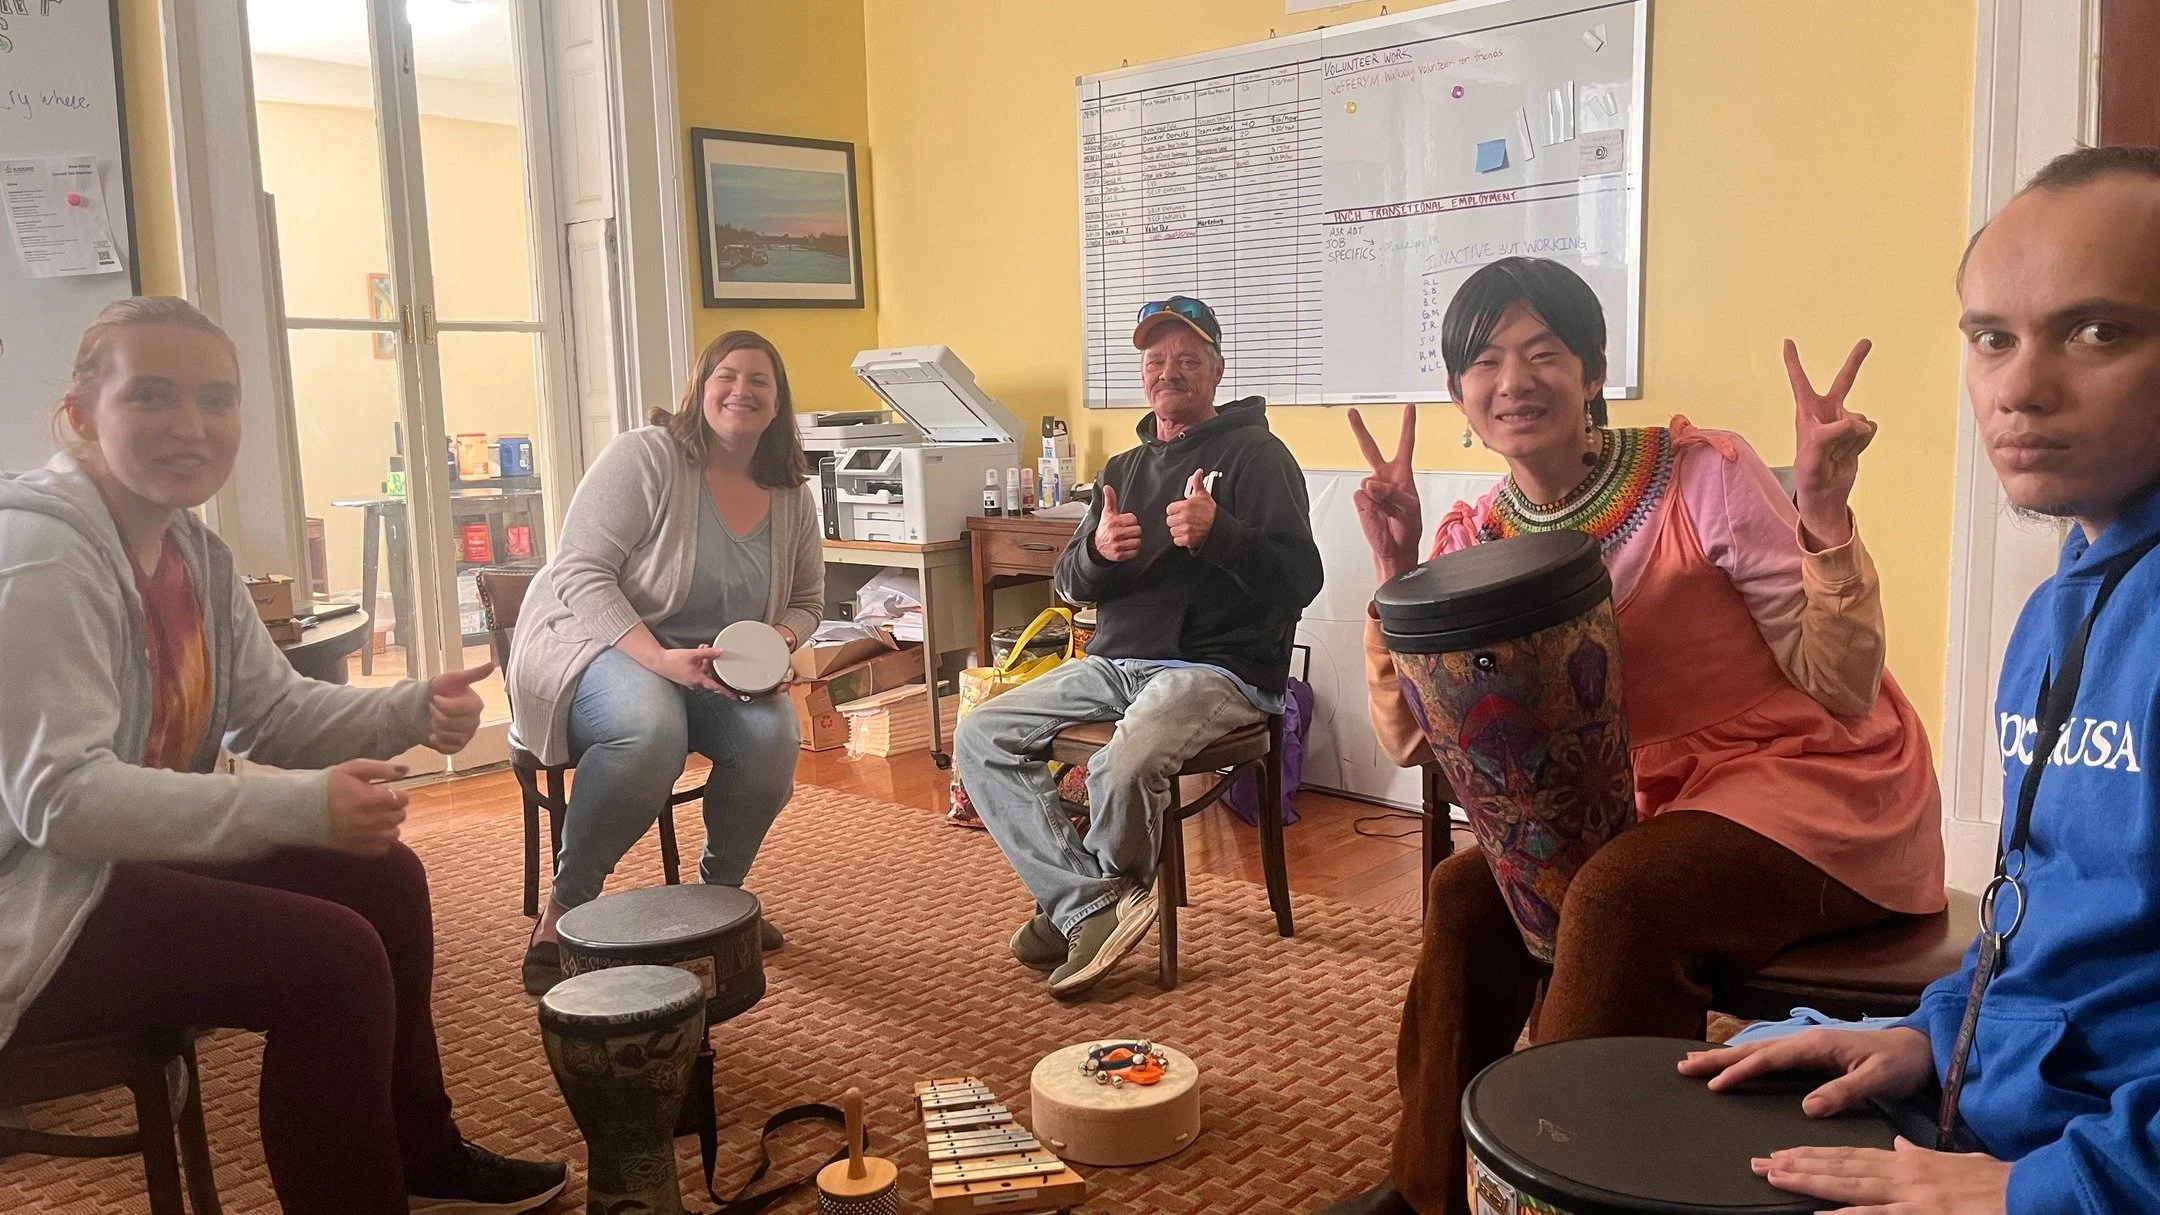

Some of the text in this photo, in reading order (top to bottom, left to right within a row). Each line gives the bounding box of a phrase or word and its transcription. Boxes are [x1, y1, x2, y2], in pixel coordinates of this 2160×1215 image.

[1324, 48, 1412, 77] VOLUNTEER WORK
[1166, 130, 1189, 139] Donuts
[1334, 191, 1517, 223] HVCH TRANSITIONAL EMPLOYMENT
[1329, 227, 1345, 237] ASK
[1325, 238, 1346, 249] JOB
[1328, 249, 1376, 264] SPECIFICS
[1425, 237, 1588, 271] INACTIVE BUT WORKING
